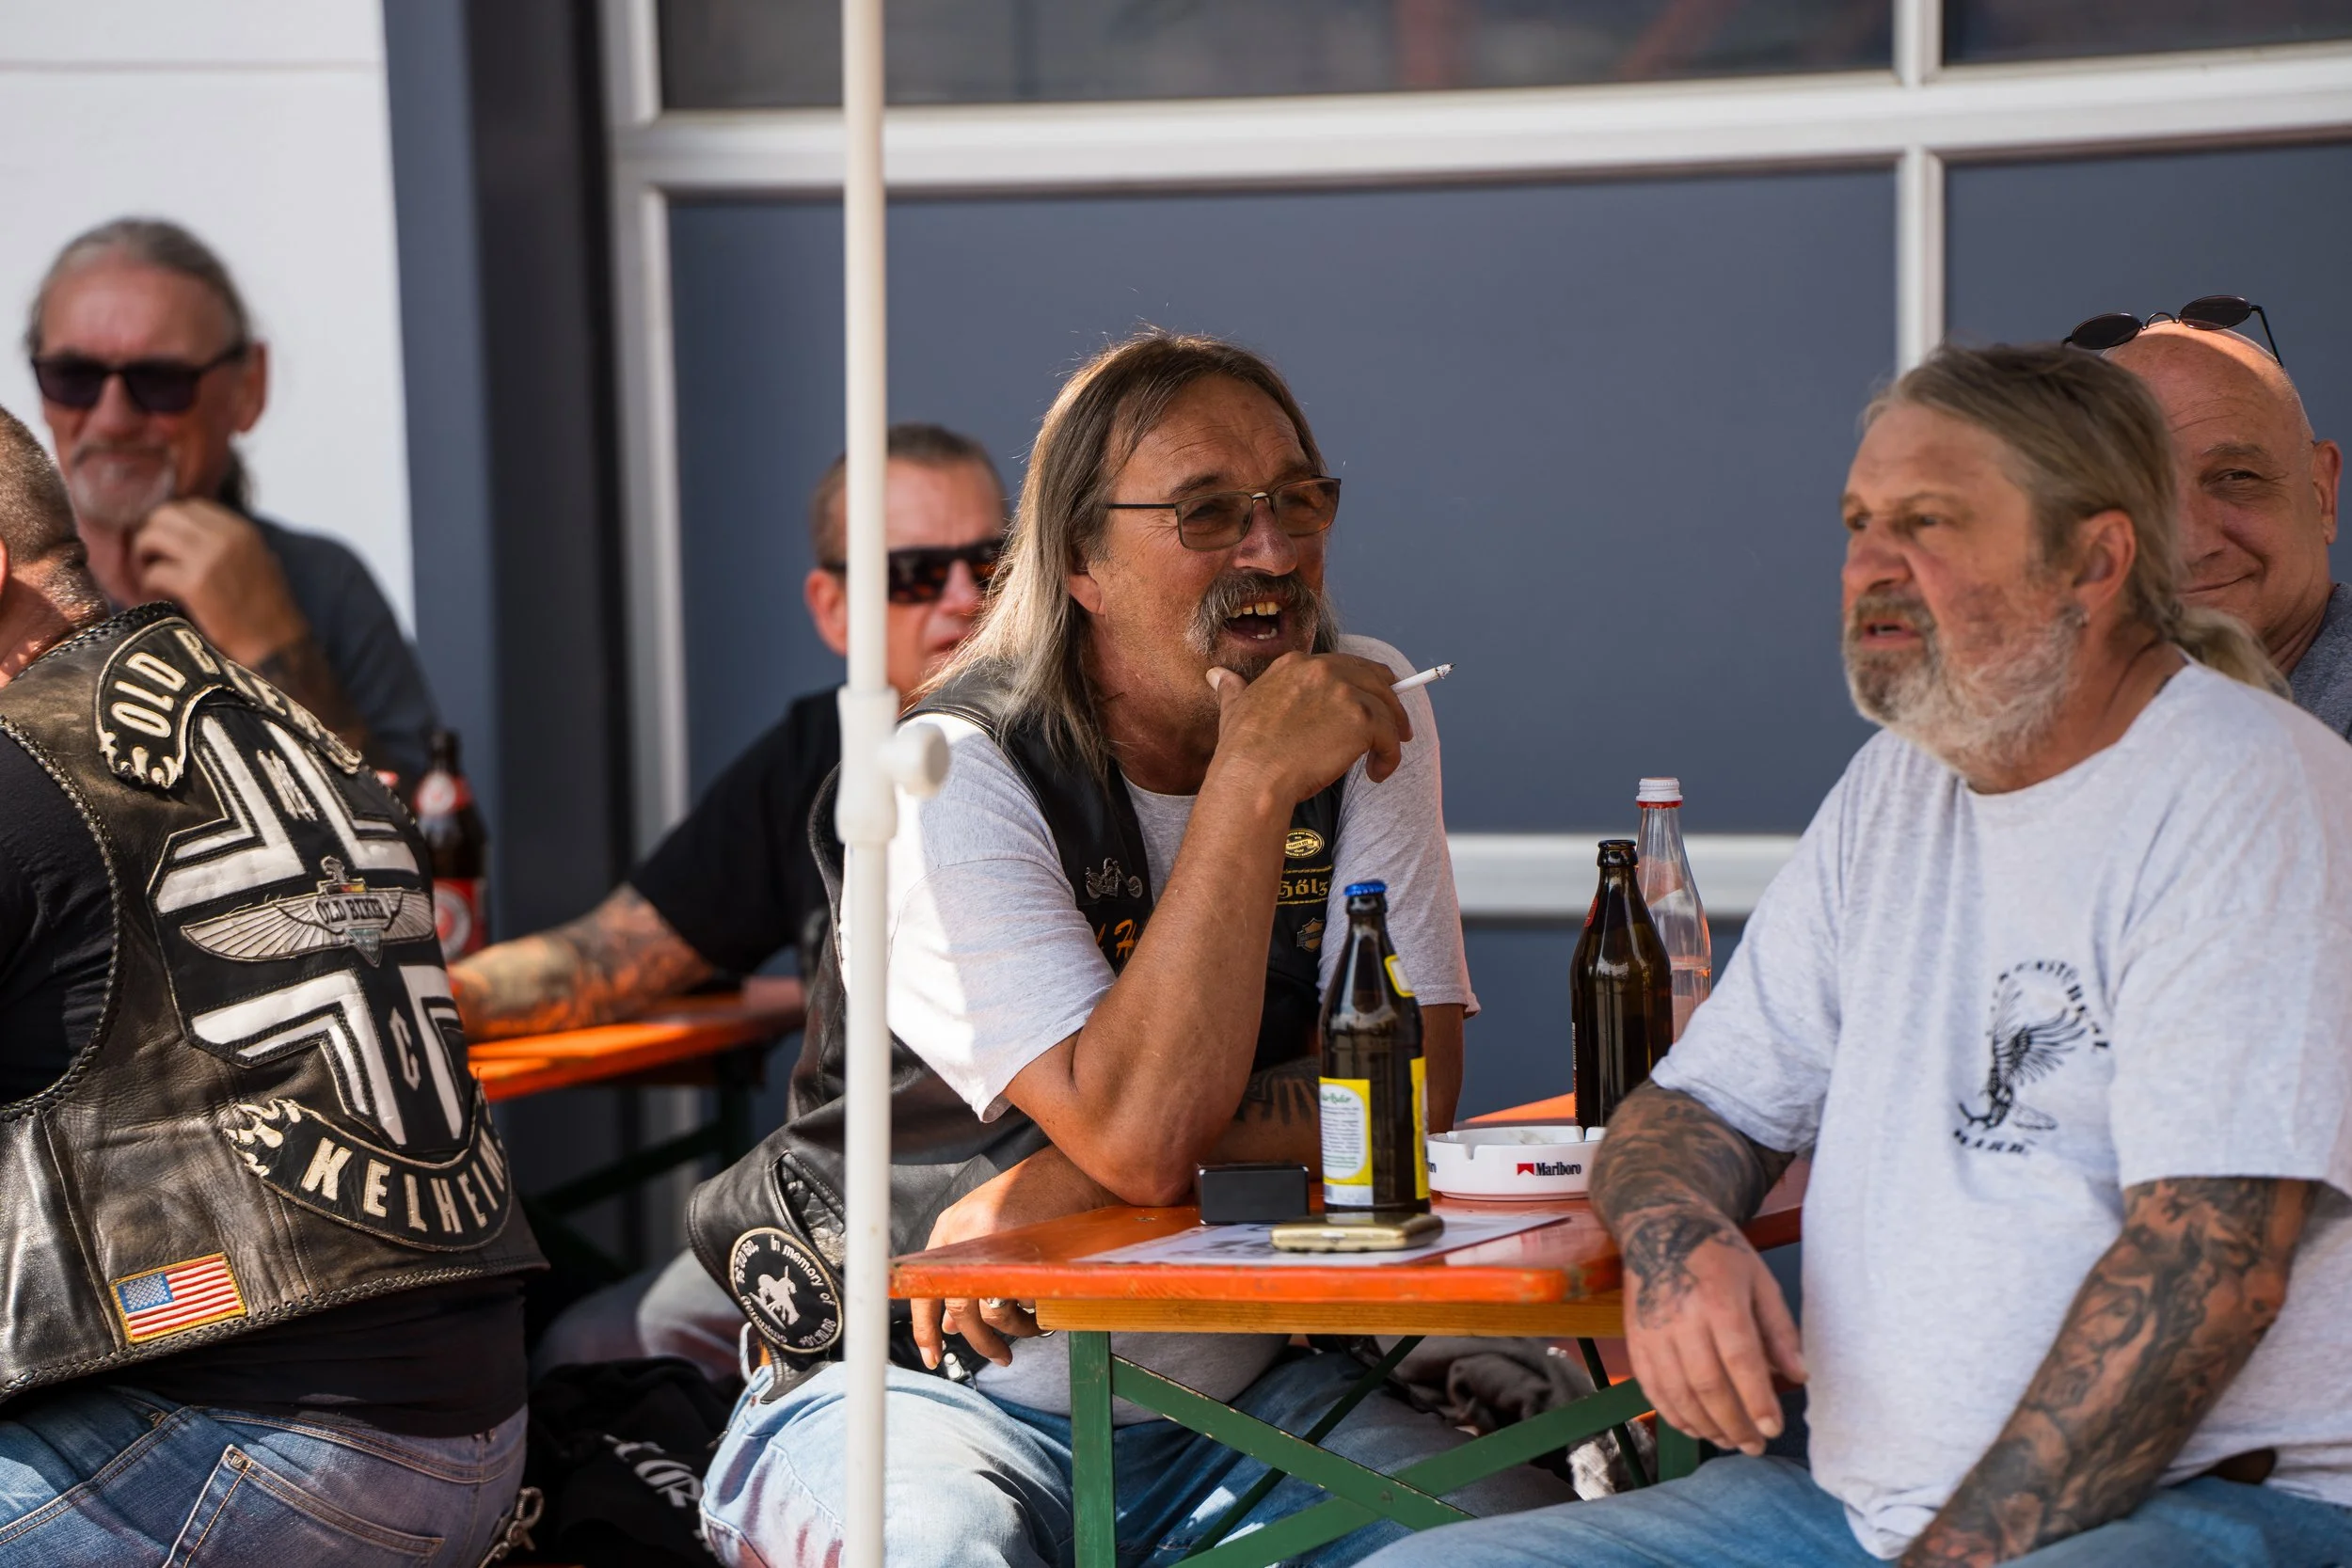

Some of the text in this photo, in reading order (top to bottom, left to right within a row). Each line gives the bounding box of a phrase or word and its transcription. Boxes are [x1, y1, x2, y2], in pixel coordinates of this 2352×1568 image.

[110, 652, 187, 738] OLD
[315, 899, 348, 925] OLD
[300, 1126, 505, 1235] KELHEIM
[1535, 1162, 1581, 1176] Marlboro
[770, 1234, 836, 1307] in memory of
